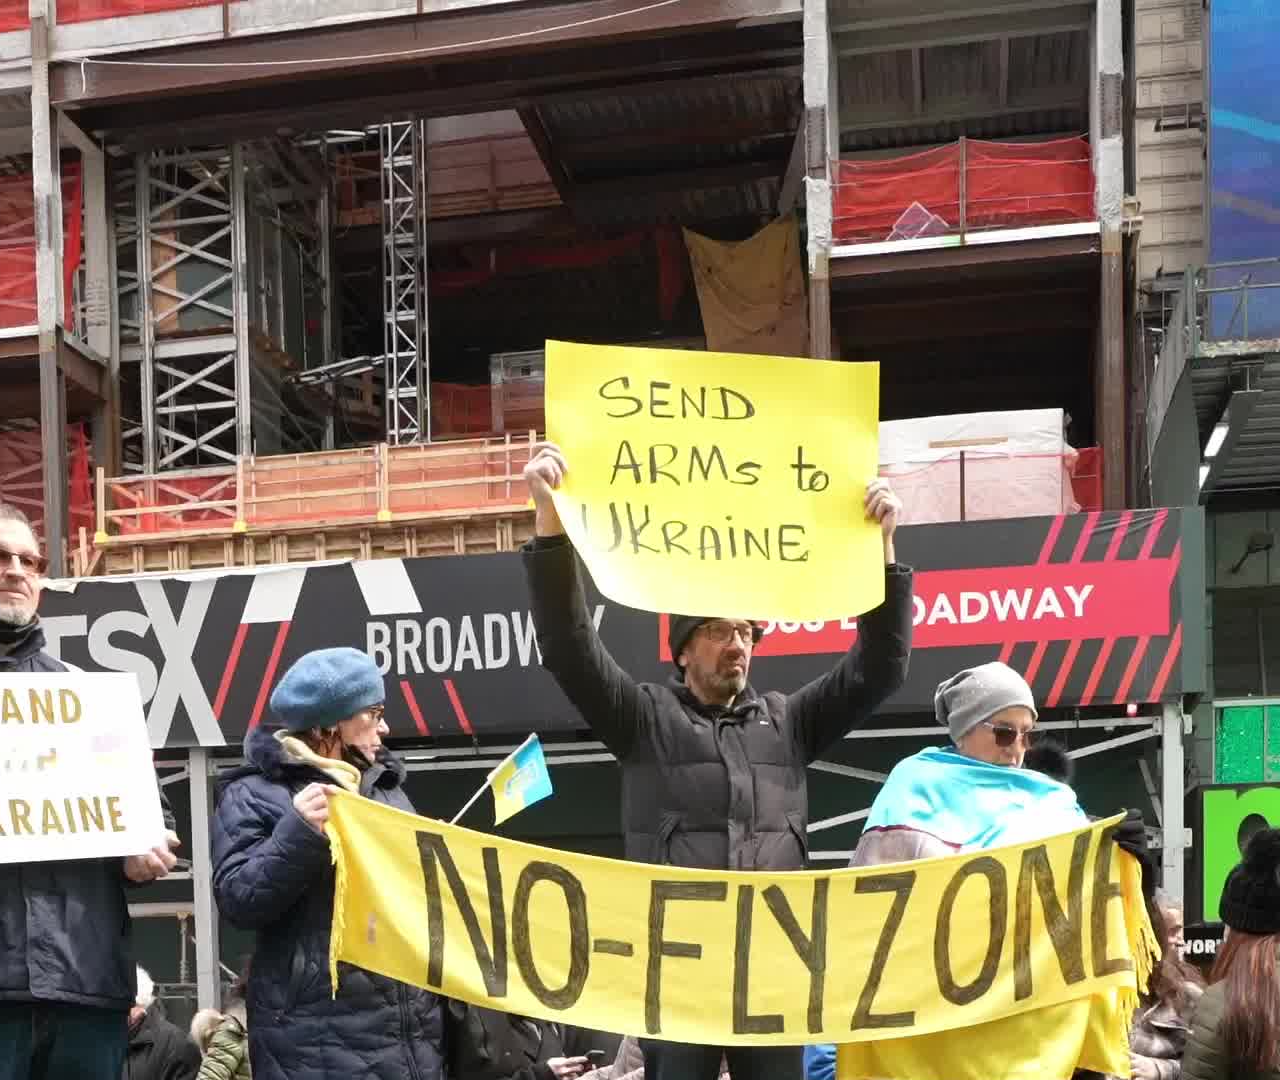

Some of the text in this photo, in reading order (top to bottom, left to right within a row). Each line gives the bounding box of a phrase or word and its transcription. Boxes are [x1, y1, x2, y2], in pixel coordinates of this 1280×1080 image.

[599, 376, 755, 420] SEND
[791, 446, 829, 492] to
[366, 604, 605, 677] BROADW
[850, 824, 1134, 1032] ZONE
